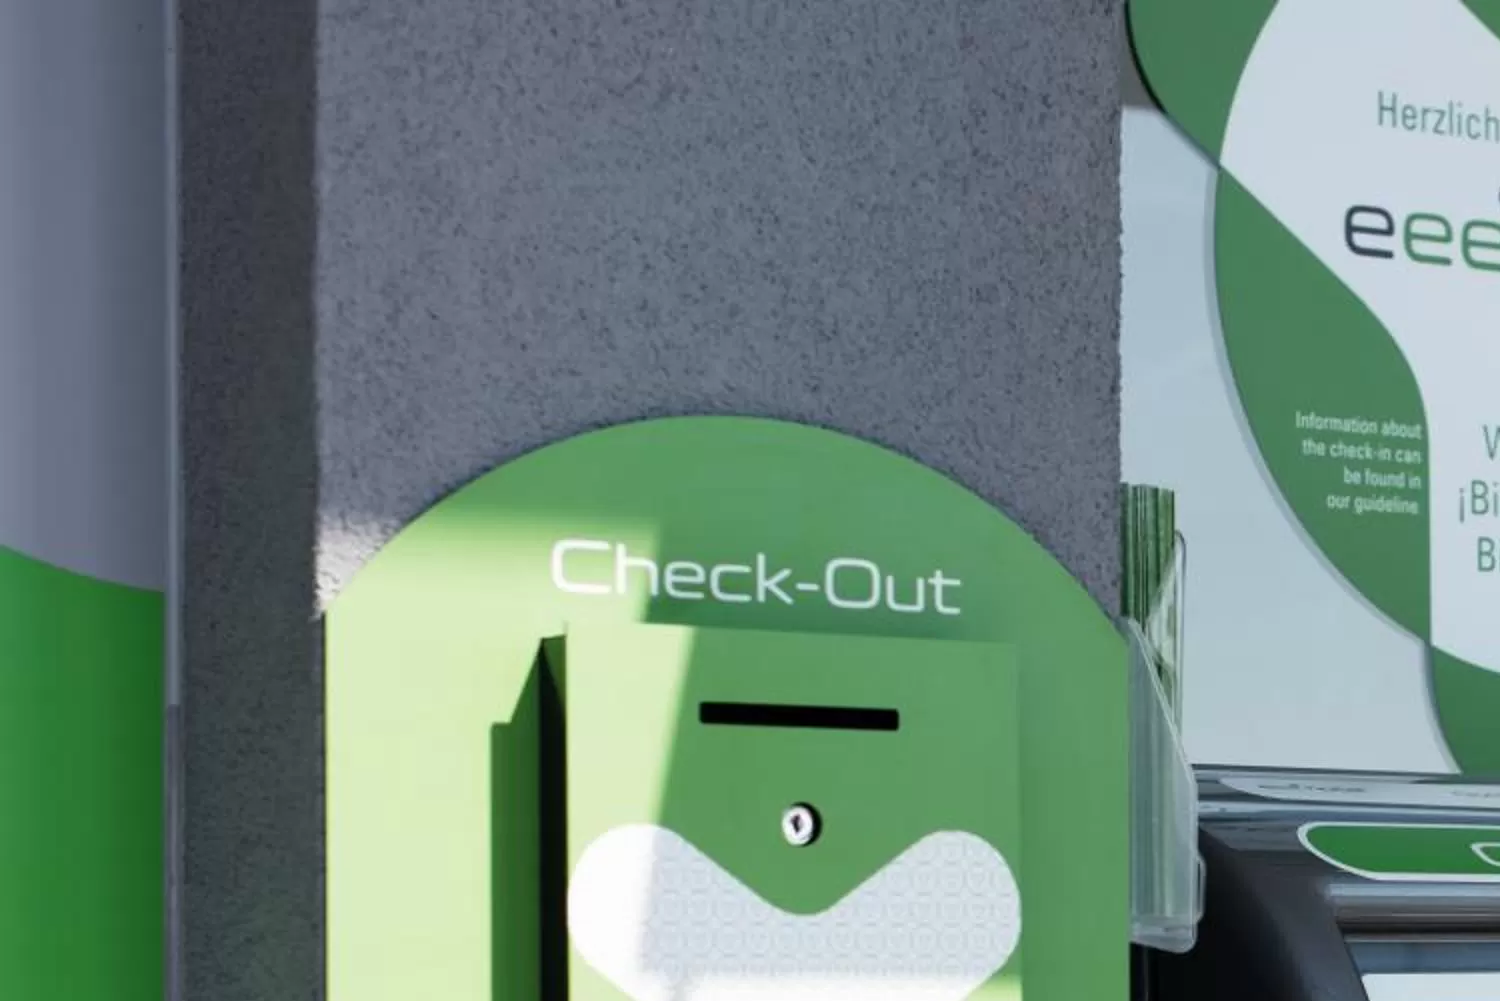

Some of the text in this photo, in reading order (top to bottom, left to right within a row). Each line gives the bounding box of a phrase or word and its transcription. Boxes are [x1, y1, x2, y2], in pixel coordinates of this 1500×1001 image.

[1377, 90, 1500, 143] Herzlich
[1295, 410, 1422, 440] Information about
[1302, 438, 1422, 464] the check-in can
[1343, 464, 1422, 489] be found in
[1326, 494, 1350, 509] our
[551, 538, 962, 615] Check-Out
